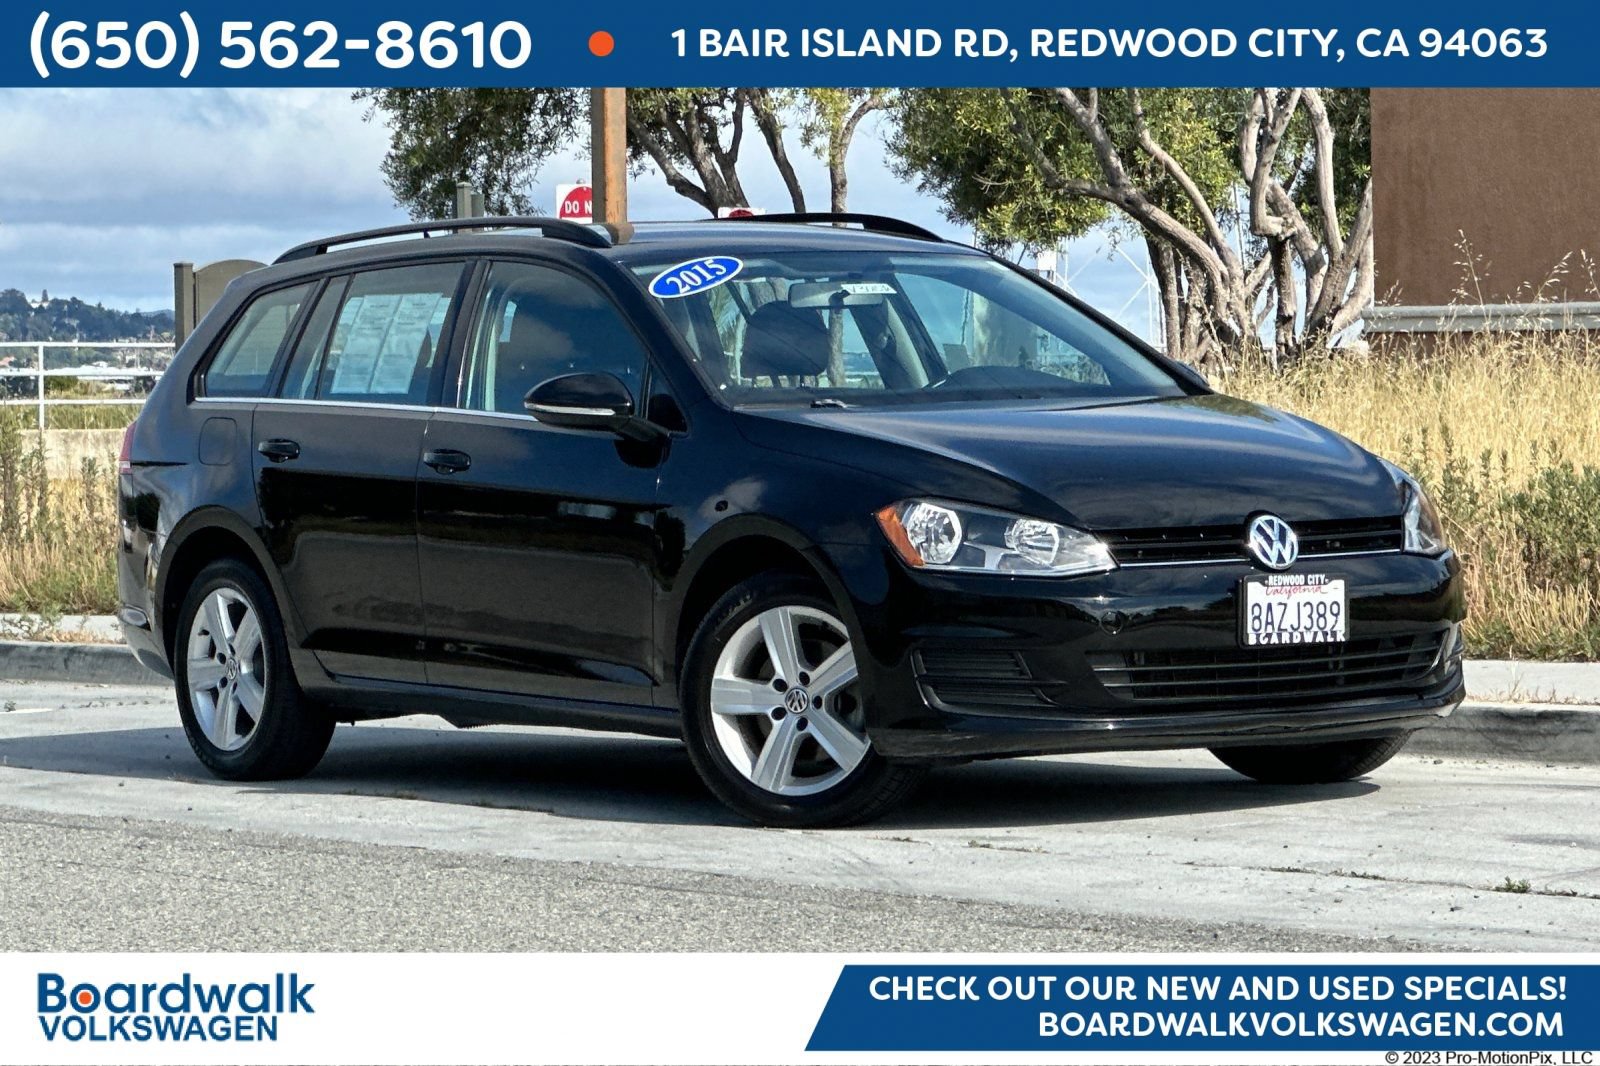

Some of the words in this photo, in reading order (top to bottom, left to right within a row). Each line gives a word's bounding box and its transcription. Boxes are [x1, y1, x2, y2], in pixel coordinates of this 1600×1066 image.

[564, 200, 580, 214] DO
[665, 258, 728, 295] 2015
[1268, 574, 1305, 586] REDWOOD
[1307, 573, 1326, 586] CITY
[1251, 600, 1342, 633] 8AZJ389
